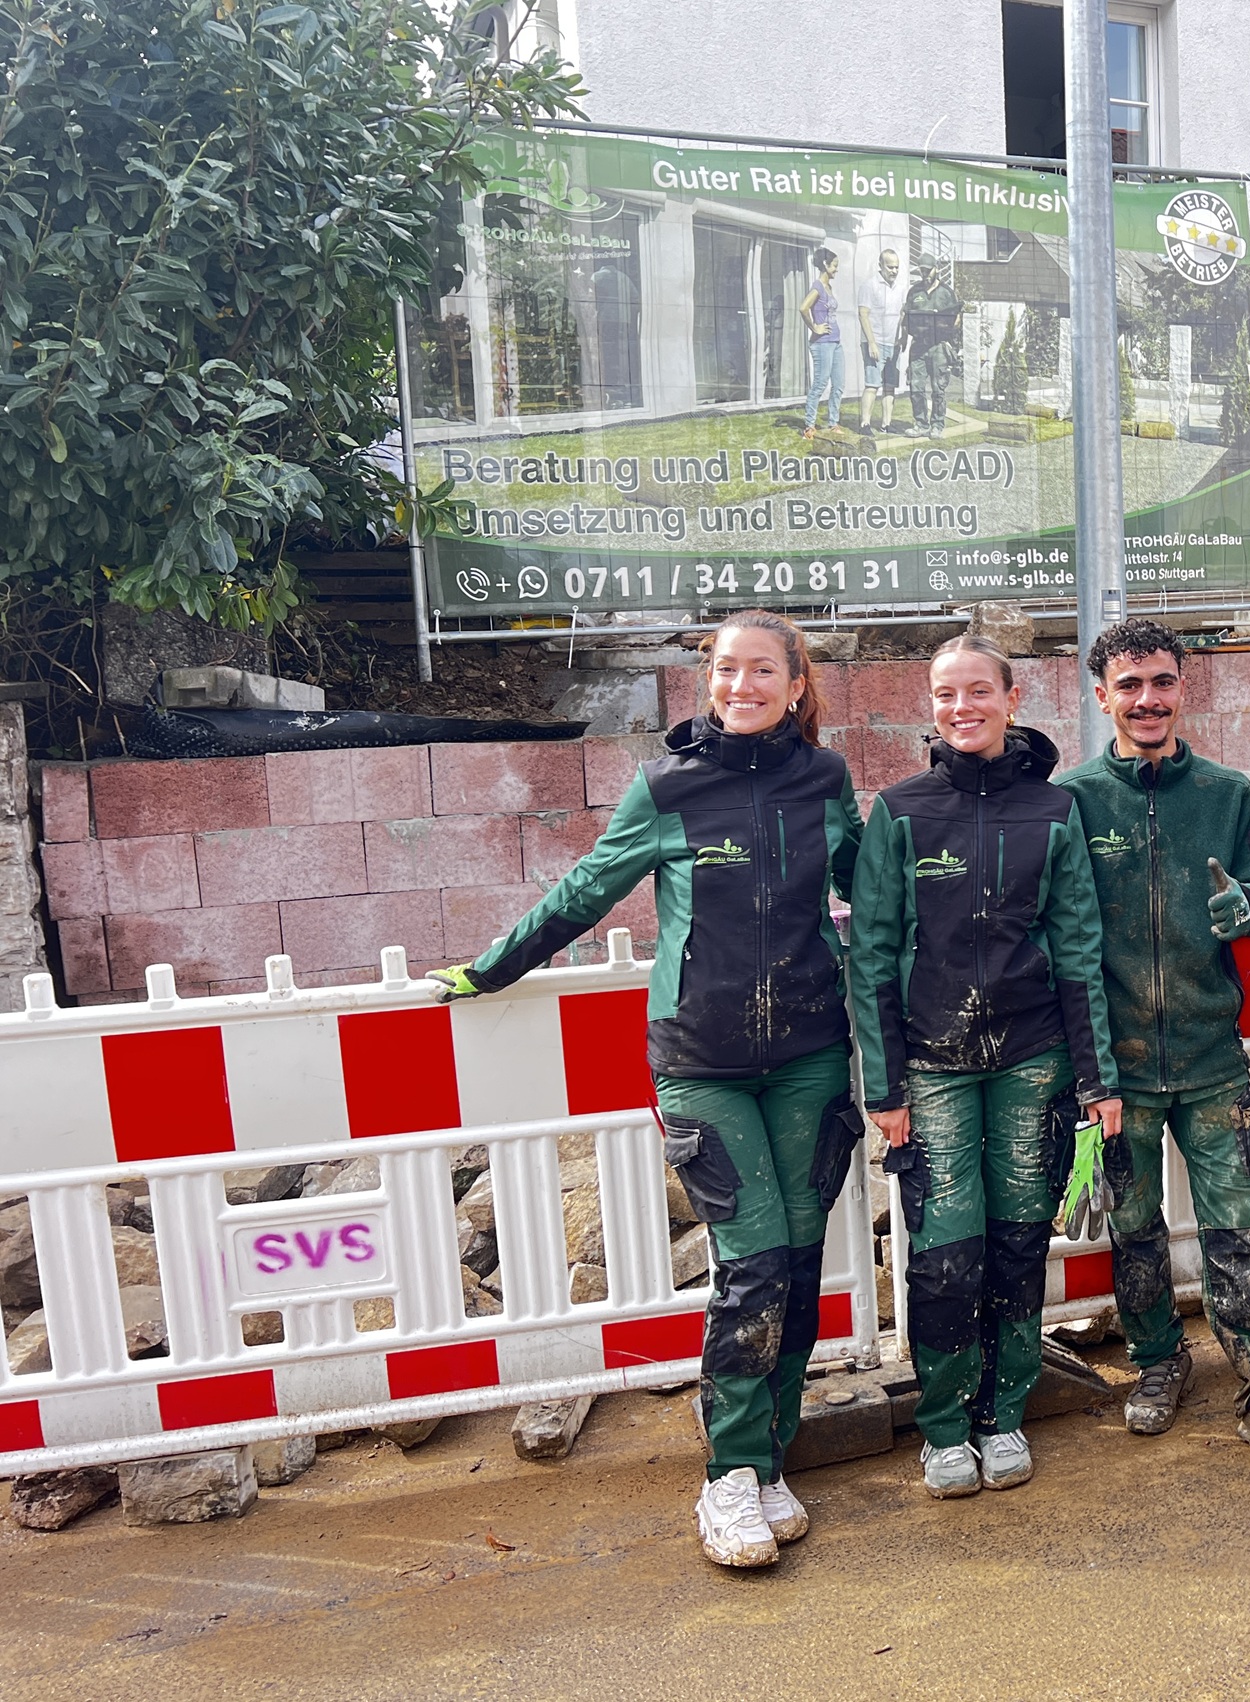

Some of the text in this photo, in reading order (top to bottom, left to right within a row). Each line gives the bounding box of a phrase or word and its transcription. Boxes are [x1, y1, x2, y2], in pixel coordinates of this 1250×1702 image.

[653, 160, 740, 191] Guter
[750, 167, 802, 194] Rat
[810, 168, 844, 195] ist
[852, 170, 895, 197] bei
[904, 177, 956, 201] uns
[1173, 194, 1233, 231] MEISTER
[559, 232, 631, 250] GaLaBau
[1170, 243, 1228, 280] BETRIEB
[442, 448, 1014, 493] Beratung und Planung (CAD)
[453, 499, 978, 541] Umsetzung und Betreuung
[955, 548, 1070, 568] info@s-glb.de
[1123, 532, 1243, 549] TROHGÄU GaLaBau
[1172, 551, 1183, 562] 14
[564, 565, 654, 598] 0711
[671, 564, 681, 595] /
[696, 563, 739, 594] 34
[753, 562, 794, 592] 20
[809, 561, 847, 590] 81
[863, 560, 900, 590] 31
[958, 569, 1075, 589] www.s-glb.de
[1125, 567, 1205, 582] 0180 Stuttgart
[253, 1223, 376, 1274] SVS
